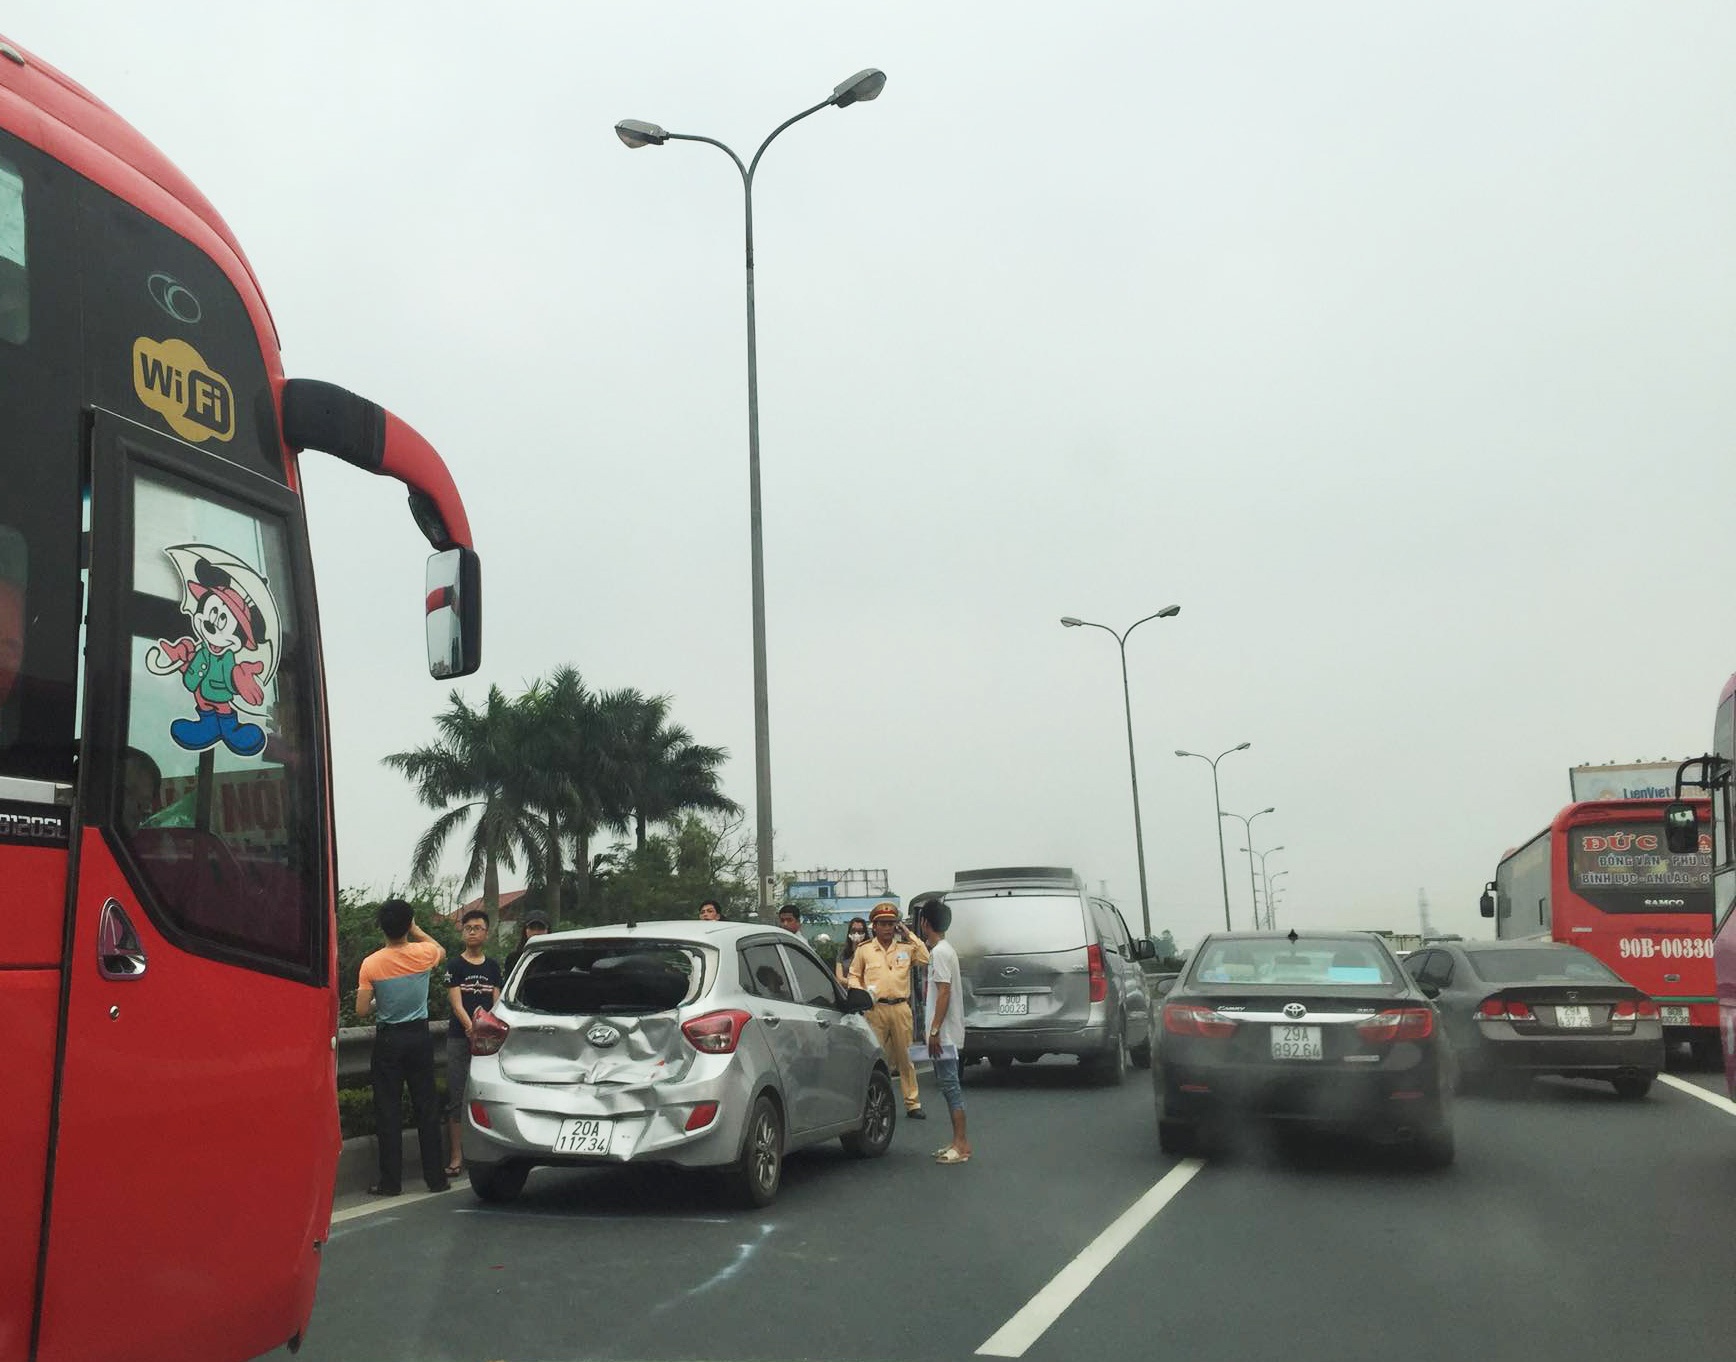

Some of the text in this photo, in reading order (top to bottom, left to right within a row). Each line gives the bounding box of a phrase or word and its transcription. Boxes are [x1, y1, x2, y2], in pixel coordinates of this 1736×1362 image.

[1582, 831, 1658, 852] ĐỨC
[1644, 899, 1685, 907] SAMCO
[1619, 937, 1715, 958] 90B-00330
[1283, 1026, 1309, 1043] 29A
[1272, 1042, 1322, 1059] 892.64
[572, 1120, 600, 1137] 20A
[559, 1135, 606, 1152] 117.34
